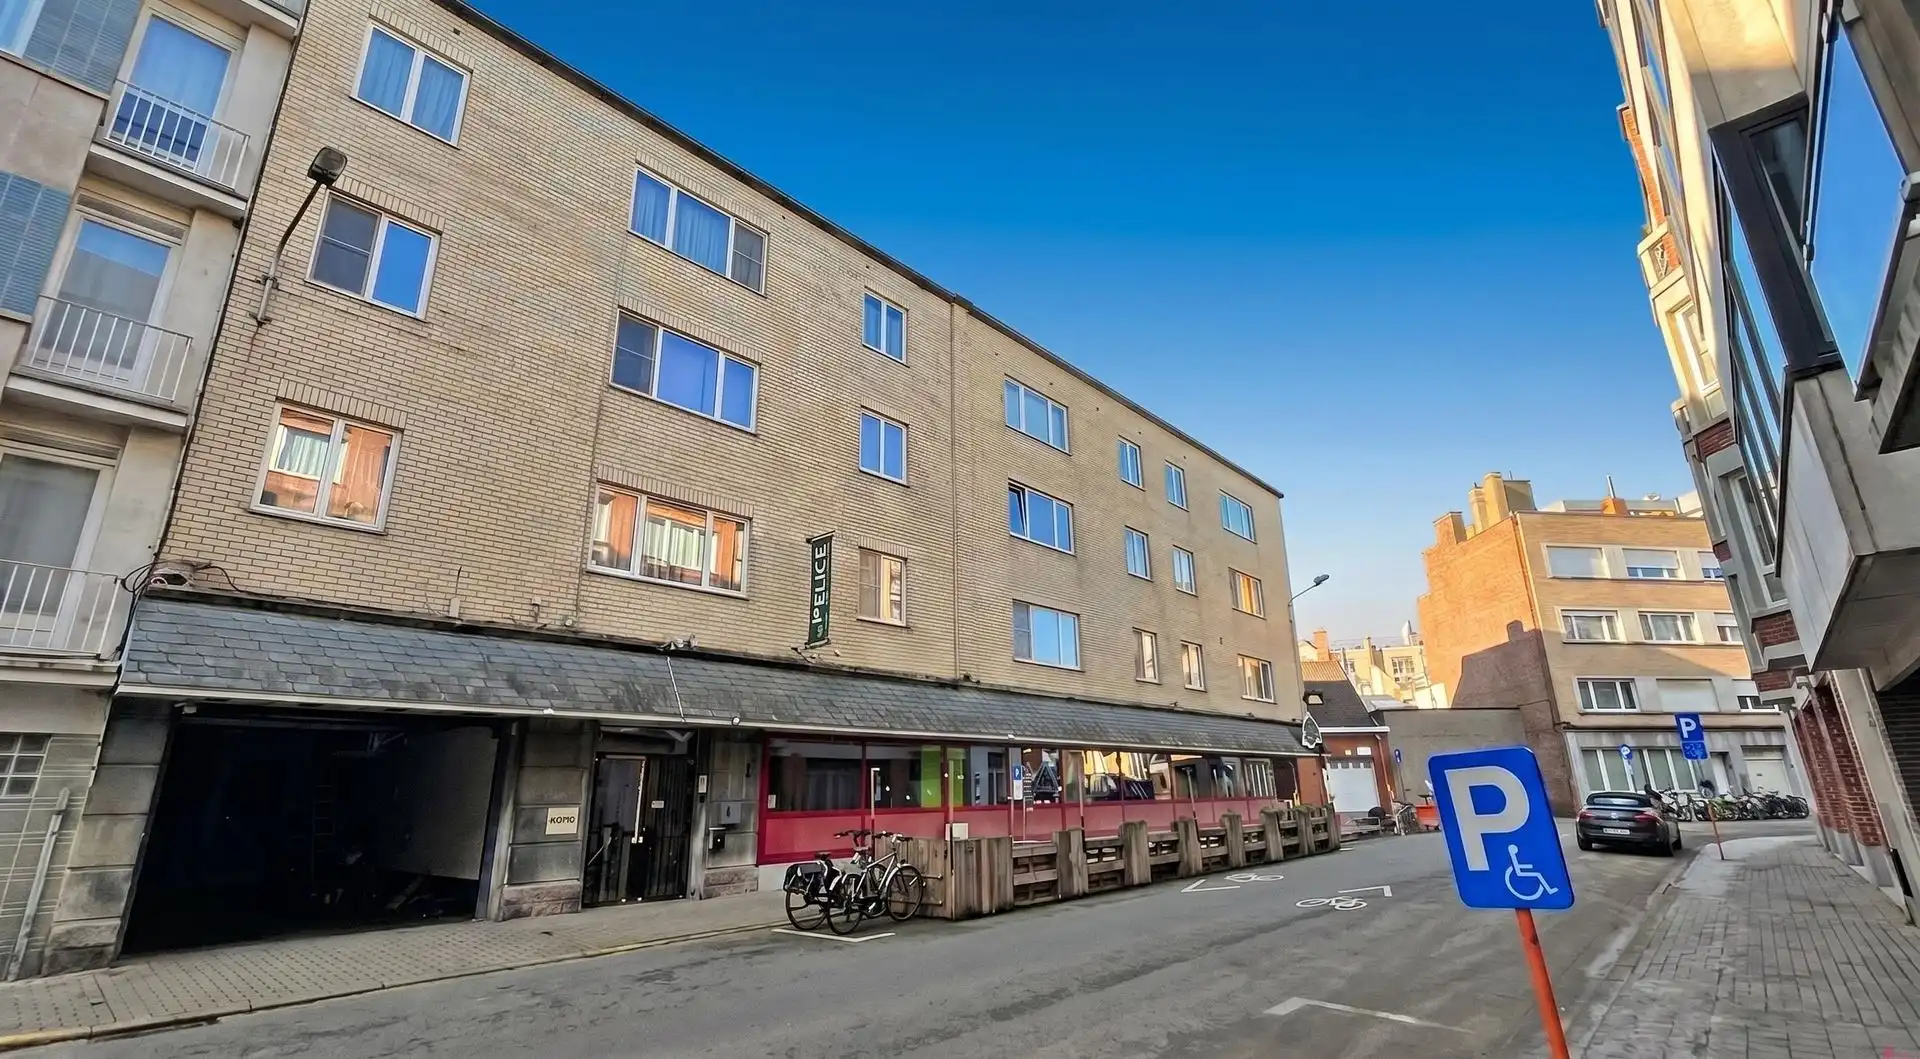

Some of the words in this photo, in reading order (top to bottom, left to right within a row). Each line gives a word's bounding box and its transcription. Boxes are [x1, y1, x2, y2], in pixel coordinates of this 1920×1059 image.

[1679, 718, 1697, 738] P
[550, 816, 575, 824] KOMO
[1444, 765, 1530, 871] P
